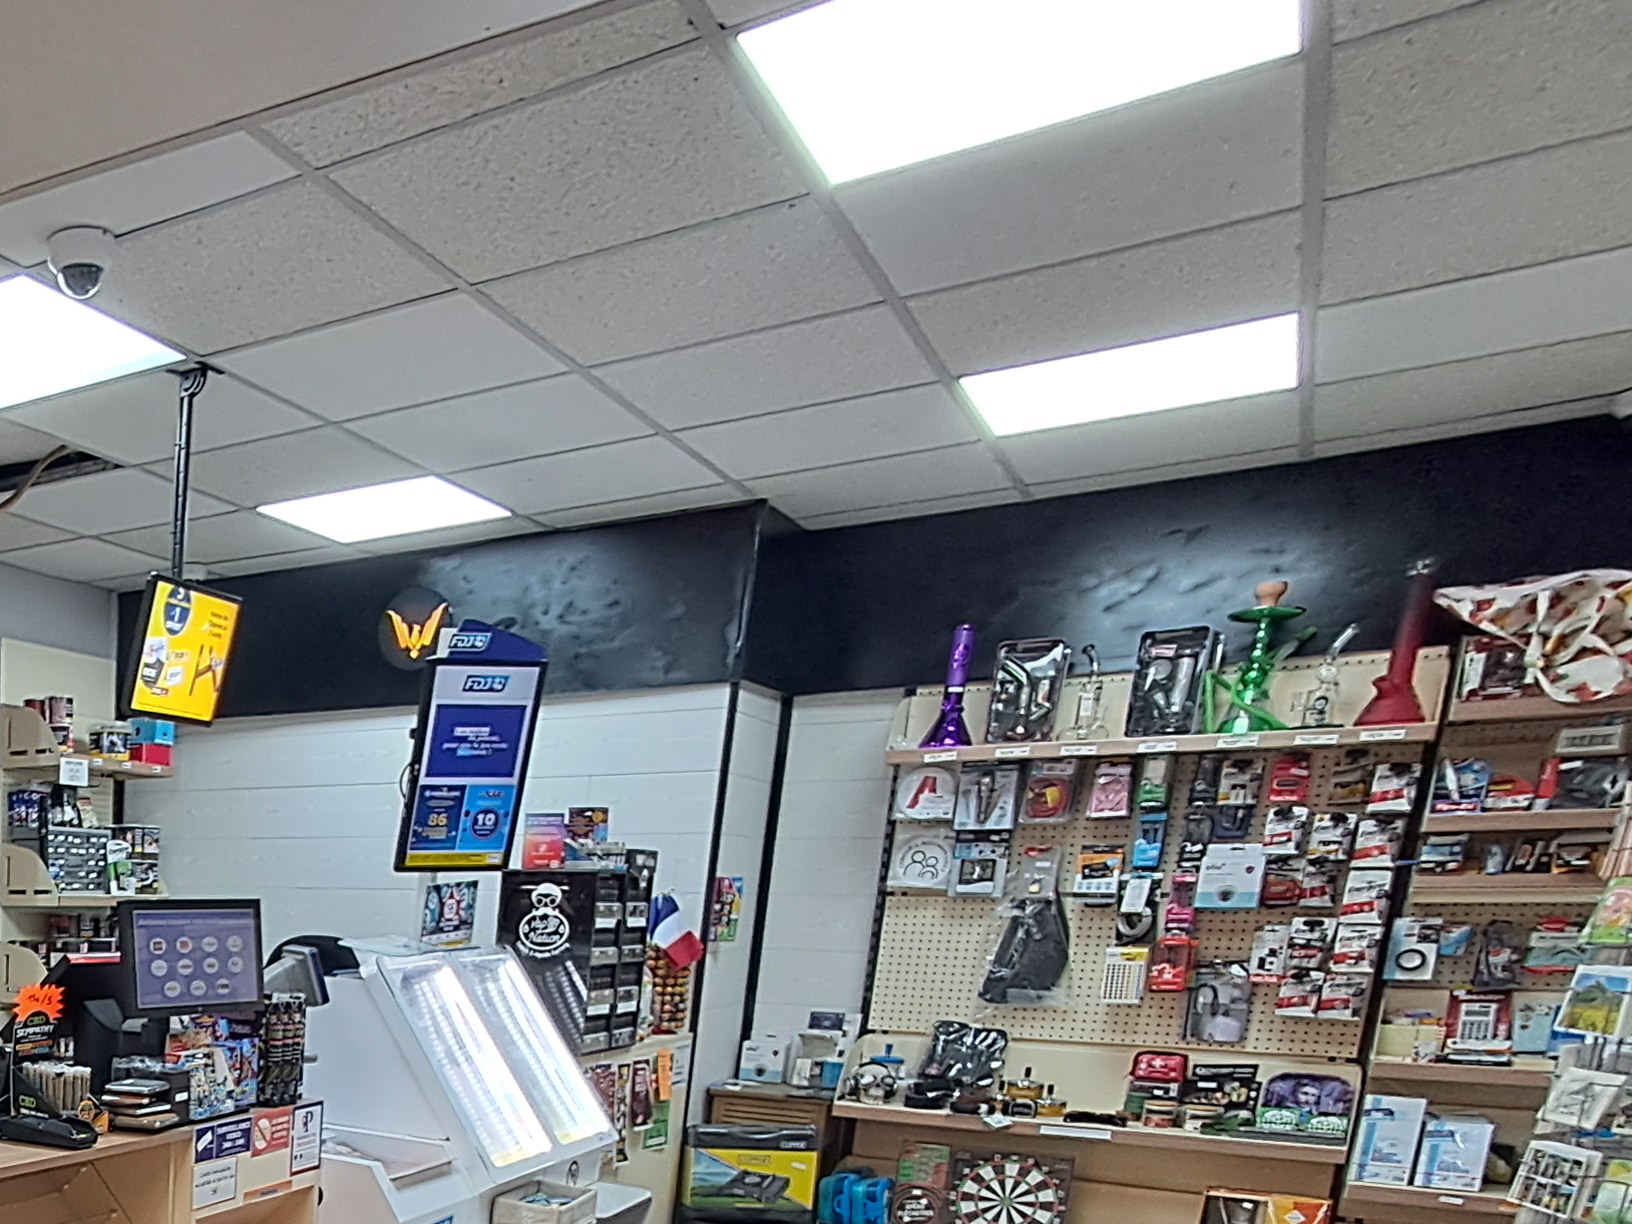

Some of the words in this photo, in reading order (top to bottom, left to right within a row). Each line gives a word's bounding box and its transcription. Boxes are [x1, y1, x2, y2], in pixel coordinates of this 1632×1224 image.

[450, 635, 475, 648] FDJ
[465, 677, 493, 690] FDJ
[428, 814, 448, 826] 86
[476, 813, 495, 826] 10
